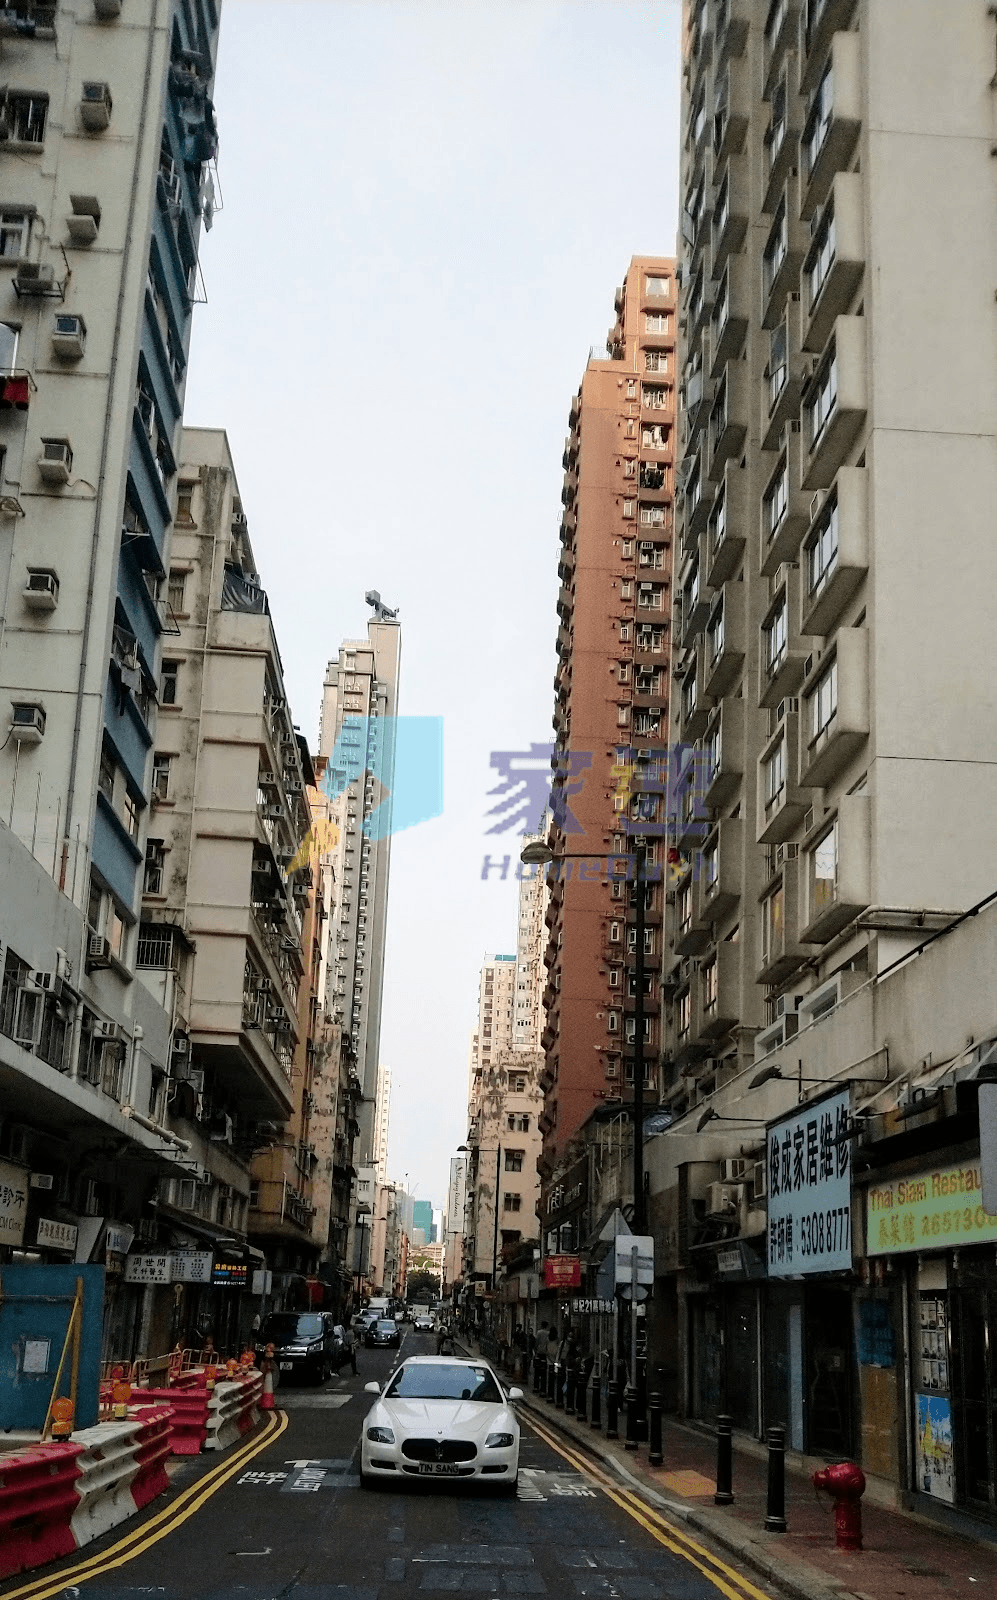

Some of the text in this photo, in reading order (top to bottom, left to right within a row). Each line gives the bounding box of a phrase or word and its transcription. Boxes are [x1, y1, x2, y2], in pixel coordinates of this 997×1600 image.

[869, 1167, 983, 1211] Thai Siam Restau
[419, 1463, 459, 1474] TIN SANG
